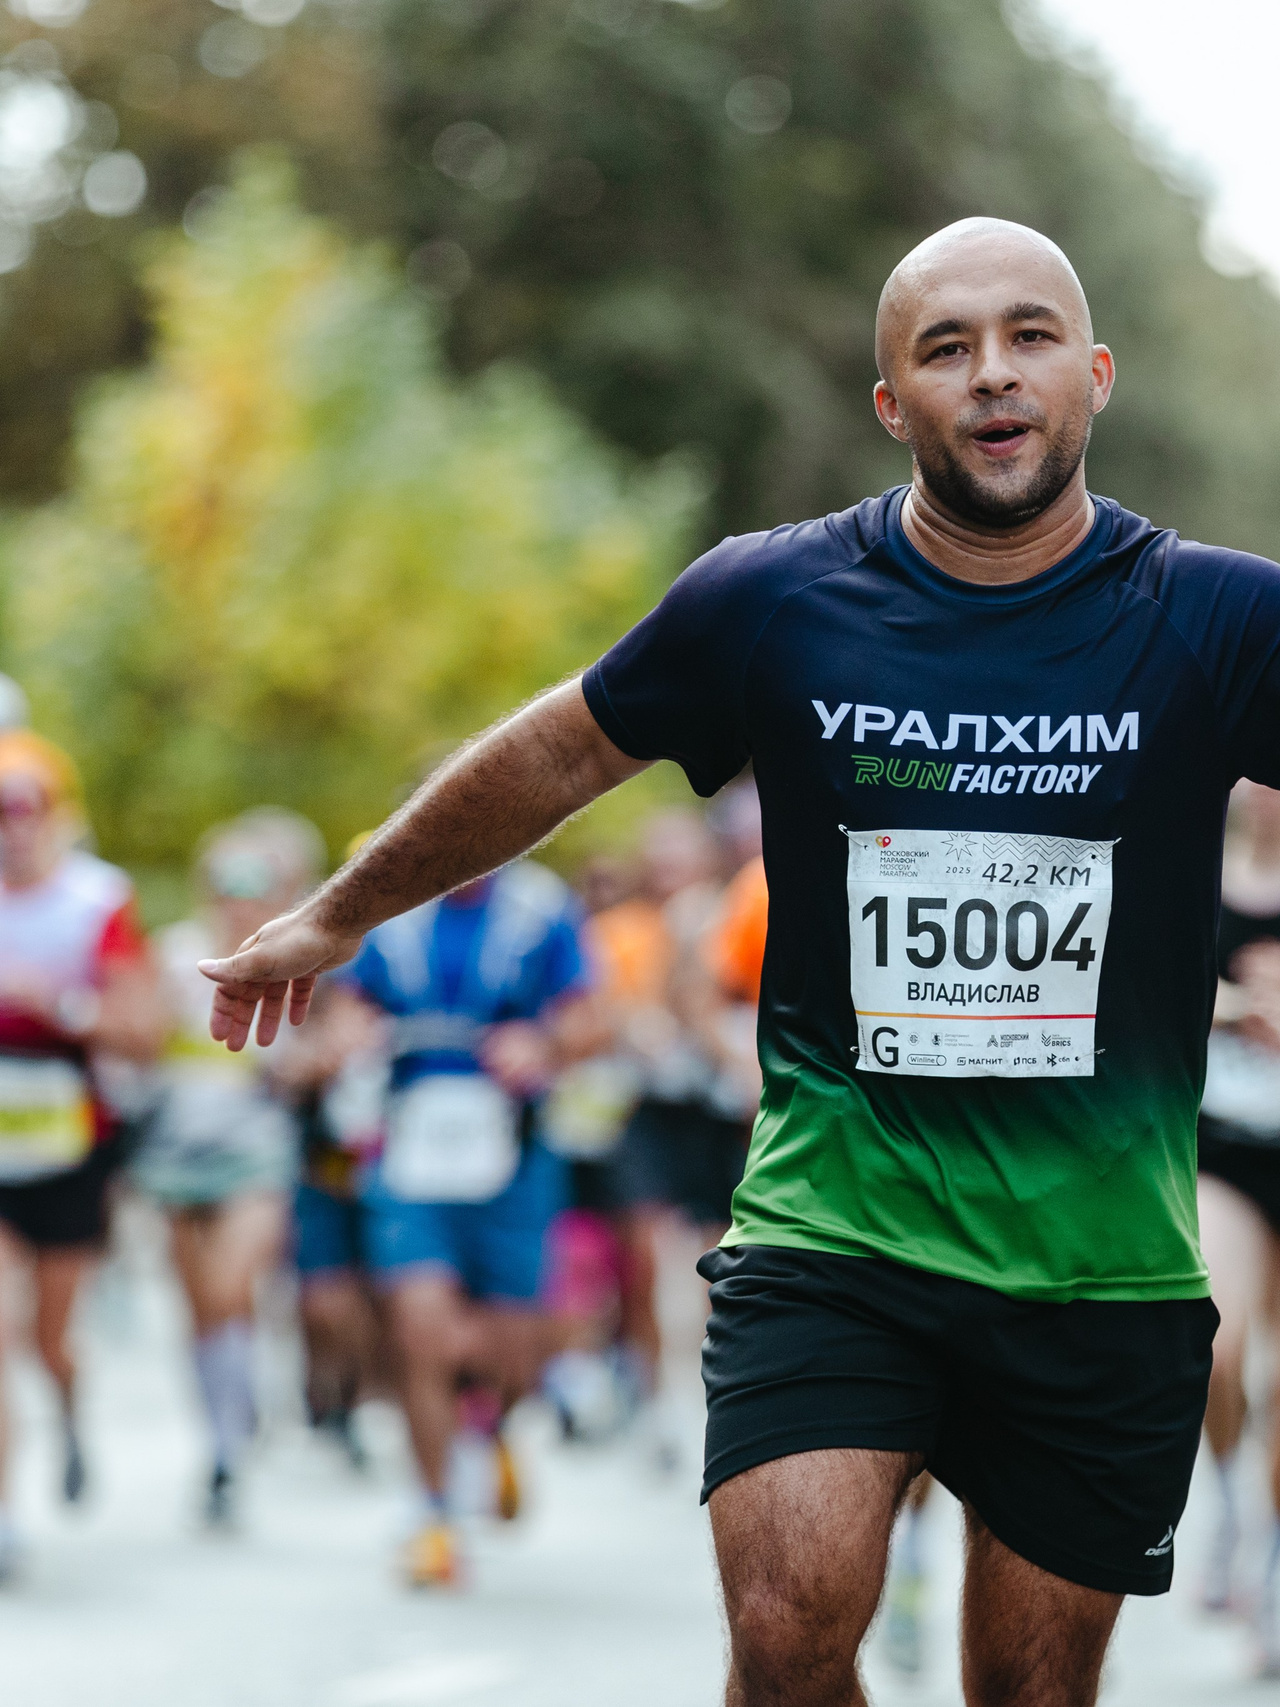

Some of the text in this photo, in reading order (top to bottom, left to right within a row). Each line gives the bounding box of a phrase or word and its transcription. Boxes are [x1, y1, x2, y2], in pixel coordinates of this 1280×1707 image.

[811, 700, 1140, 753] УРАЛХИМ
[880, 850, 930, 858] МОСКОВСКИЙ
[879, 870, 918, 878] MARATHON
[880, 863, 912, 871] MOSCOW
[945, 866, 971, 874] 2025
[982, 862, 1039, 887] 42,2
[862, 896, 1097, 972] 15004
[907, 982, 1040, 1006] ВЛАДИСЛАВ
[872, 1026, 900, 1068] G
